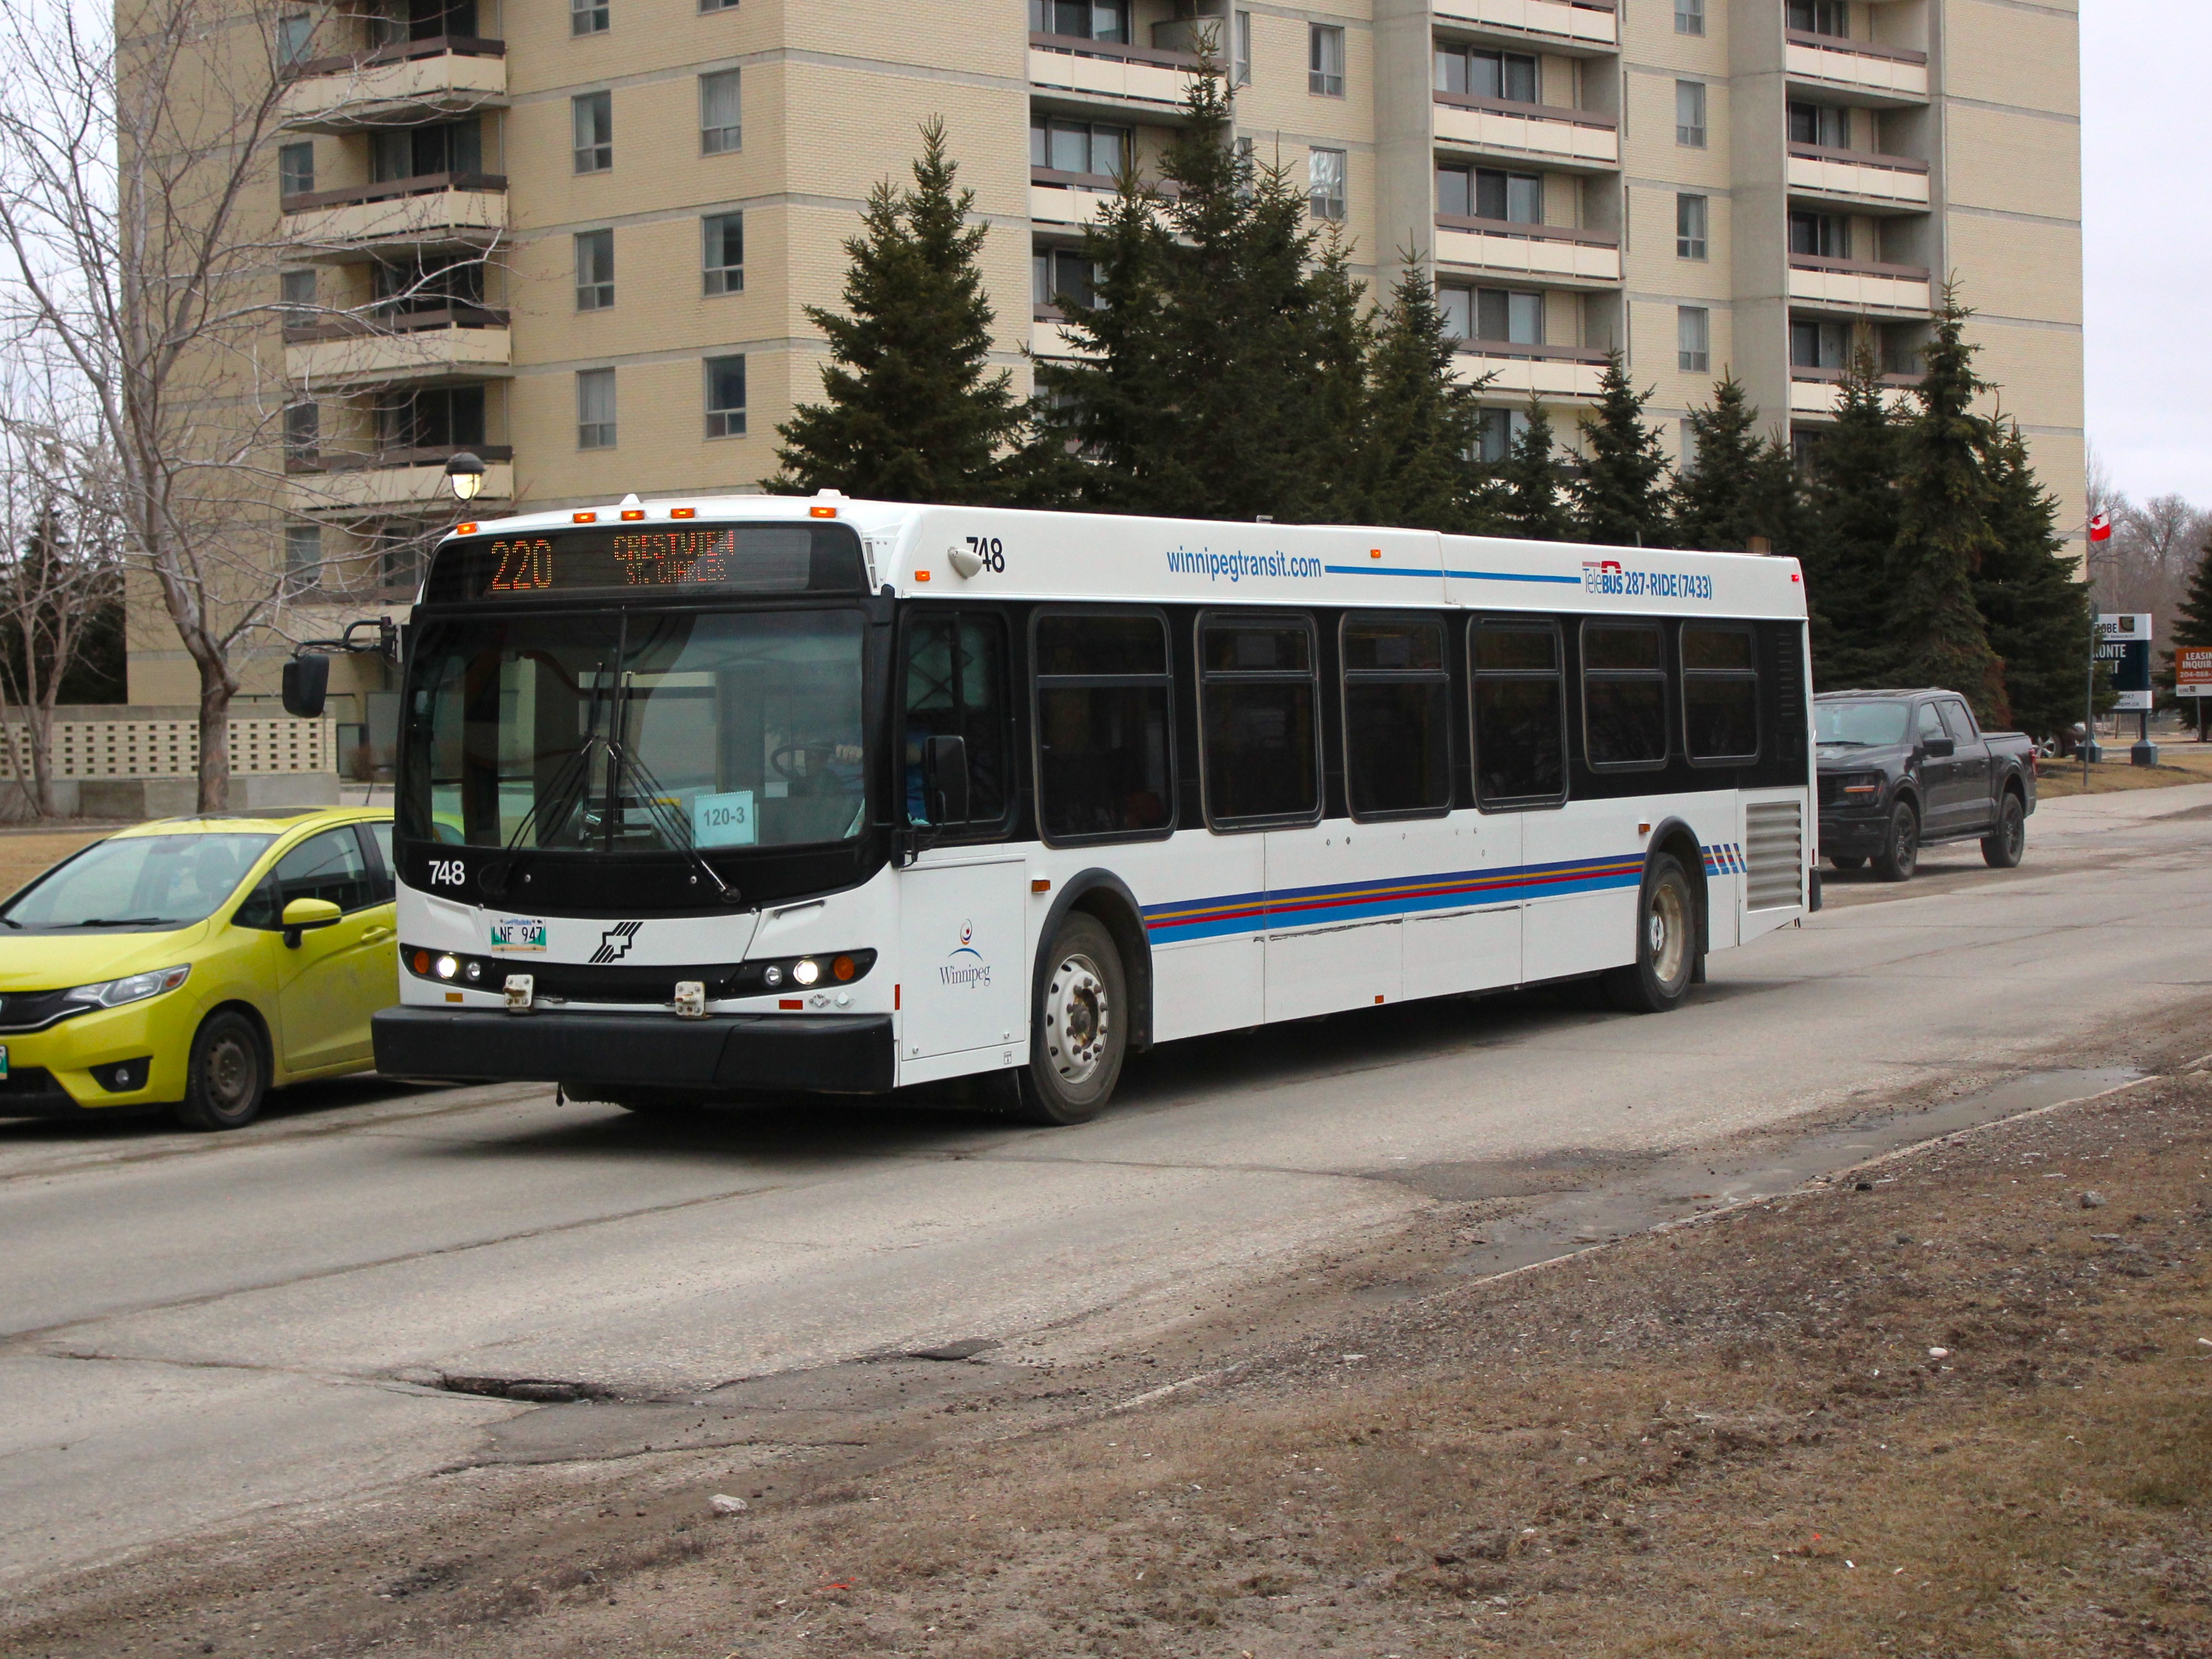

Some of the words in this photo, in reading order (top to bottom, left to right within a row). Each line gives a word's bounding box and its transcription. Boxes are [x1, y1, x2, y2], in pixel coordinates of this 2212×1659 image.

[614, 531, 734, 560] CRESTVIEW
[966, 536, 1005, 573] 748
[491, 539, 552, 590] 220
[626, 562, 649, 584] ST.
[657, 559, 727, 583] CHARLES
[1167, 546, 1322, 582] winnipegtransit.com
[1582, 568, 1622, 594] TeleBUS
[1625, 572, 1677, 597] 287-RIDE
[1678, 574, 1713, 600] (7433)
[2183, 661, 2212, 669] INQUIR
[704, 807, 745, 826] 120-3
[428, 860, 465, 885] 748
[493, 927, 513, 942] LNF
[522, 927, 543, 942] 947
[940, 964, 991, 988] Winnipeg
